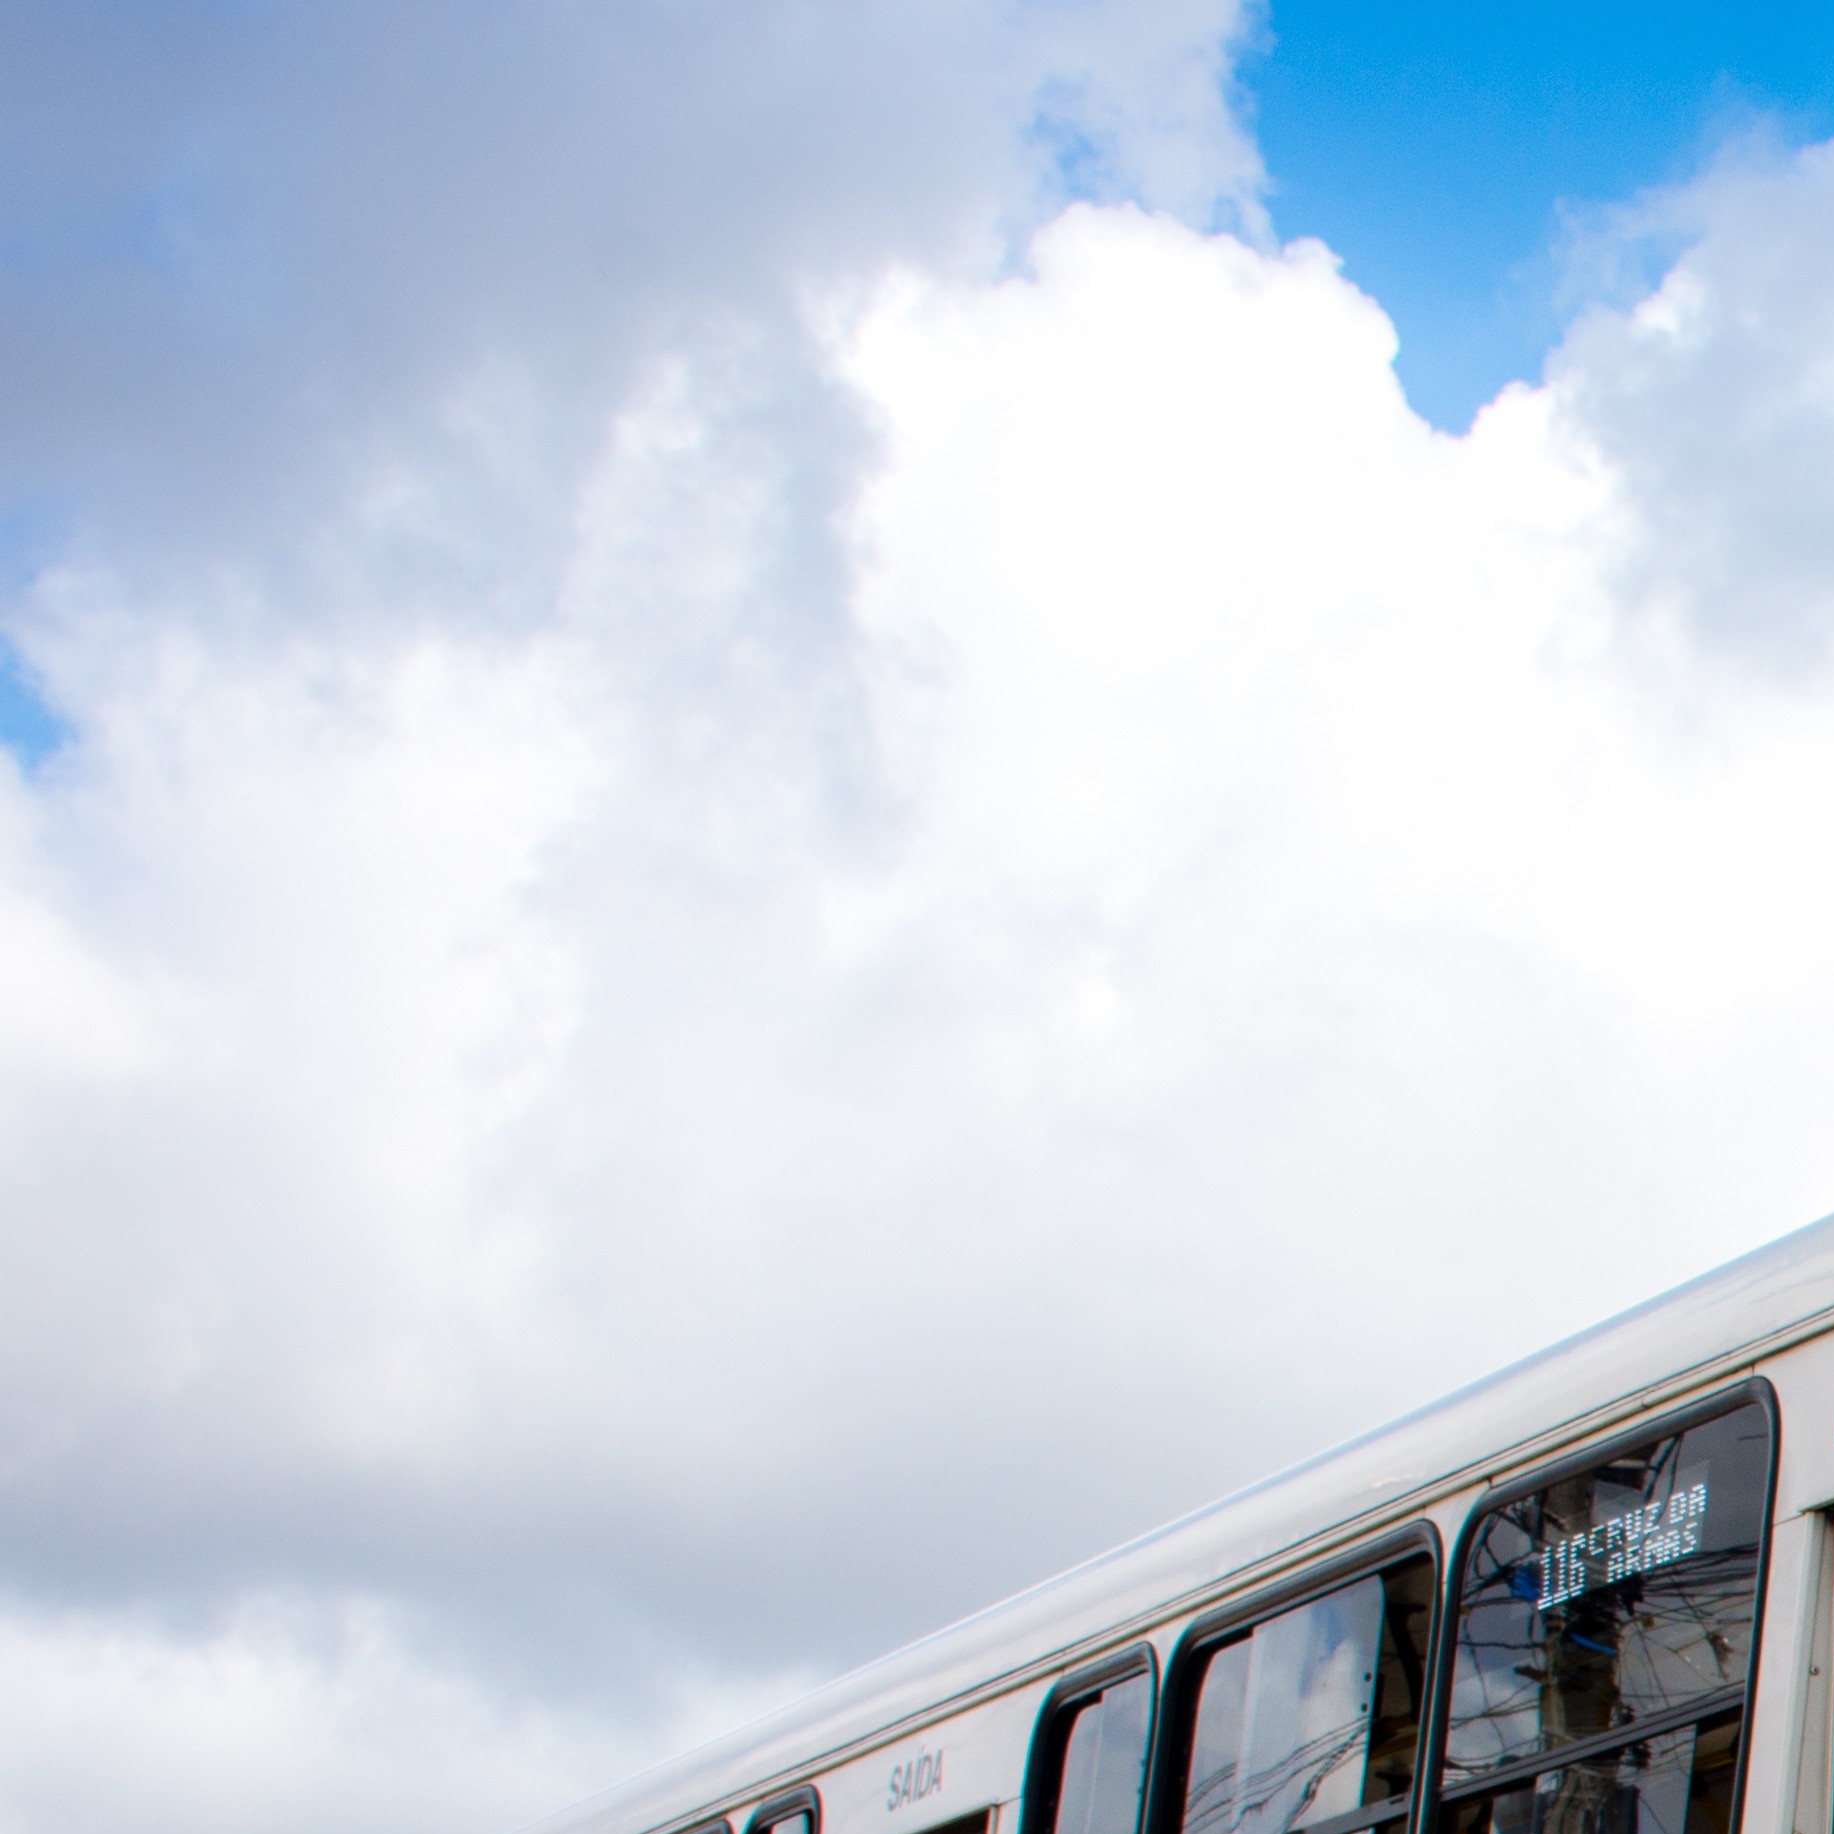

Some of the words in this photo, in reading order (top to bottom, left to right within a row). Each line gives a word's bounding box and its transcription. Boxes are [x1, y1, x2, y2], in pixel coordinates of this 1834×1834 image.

[1588, 1502, 1662, 1556] CRUZ
[1669, 1484, 1707, 1524] DA
[1606, 1521, 1698, 1584] ARMAS
[1537, 1532, 1587, 1611] 116
[884, 1743, 944, 1813] SAÍDA
